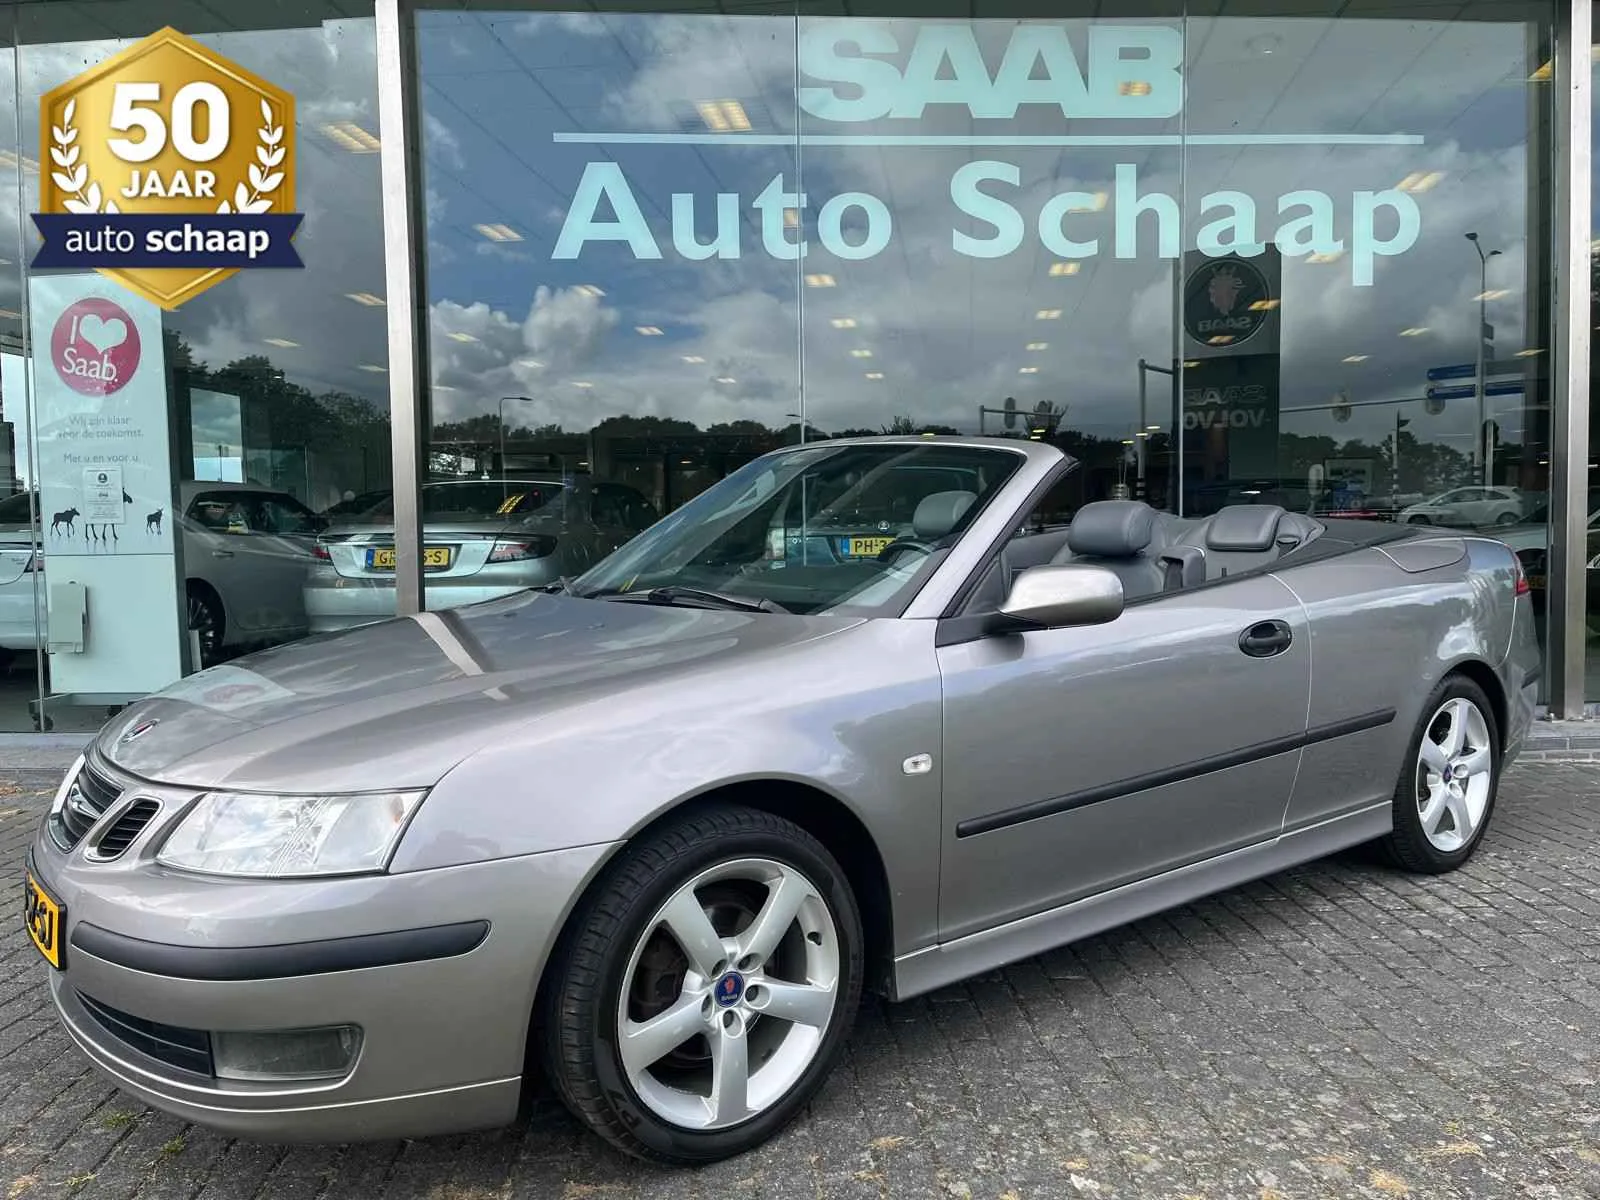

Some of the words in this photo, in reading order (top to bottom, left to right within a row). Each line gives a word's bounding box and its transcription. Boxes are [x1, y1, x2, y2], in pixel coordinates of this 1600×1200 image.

[798, 25, 1184, 121] SAAB
[551, 161, 893, 261] Auto
[950, 160, 1421, 287] Schaap
